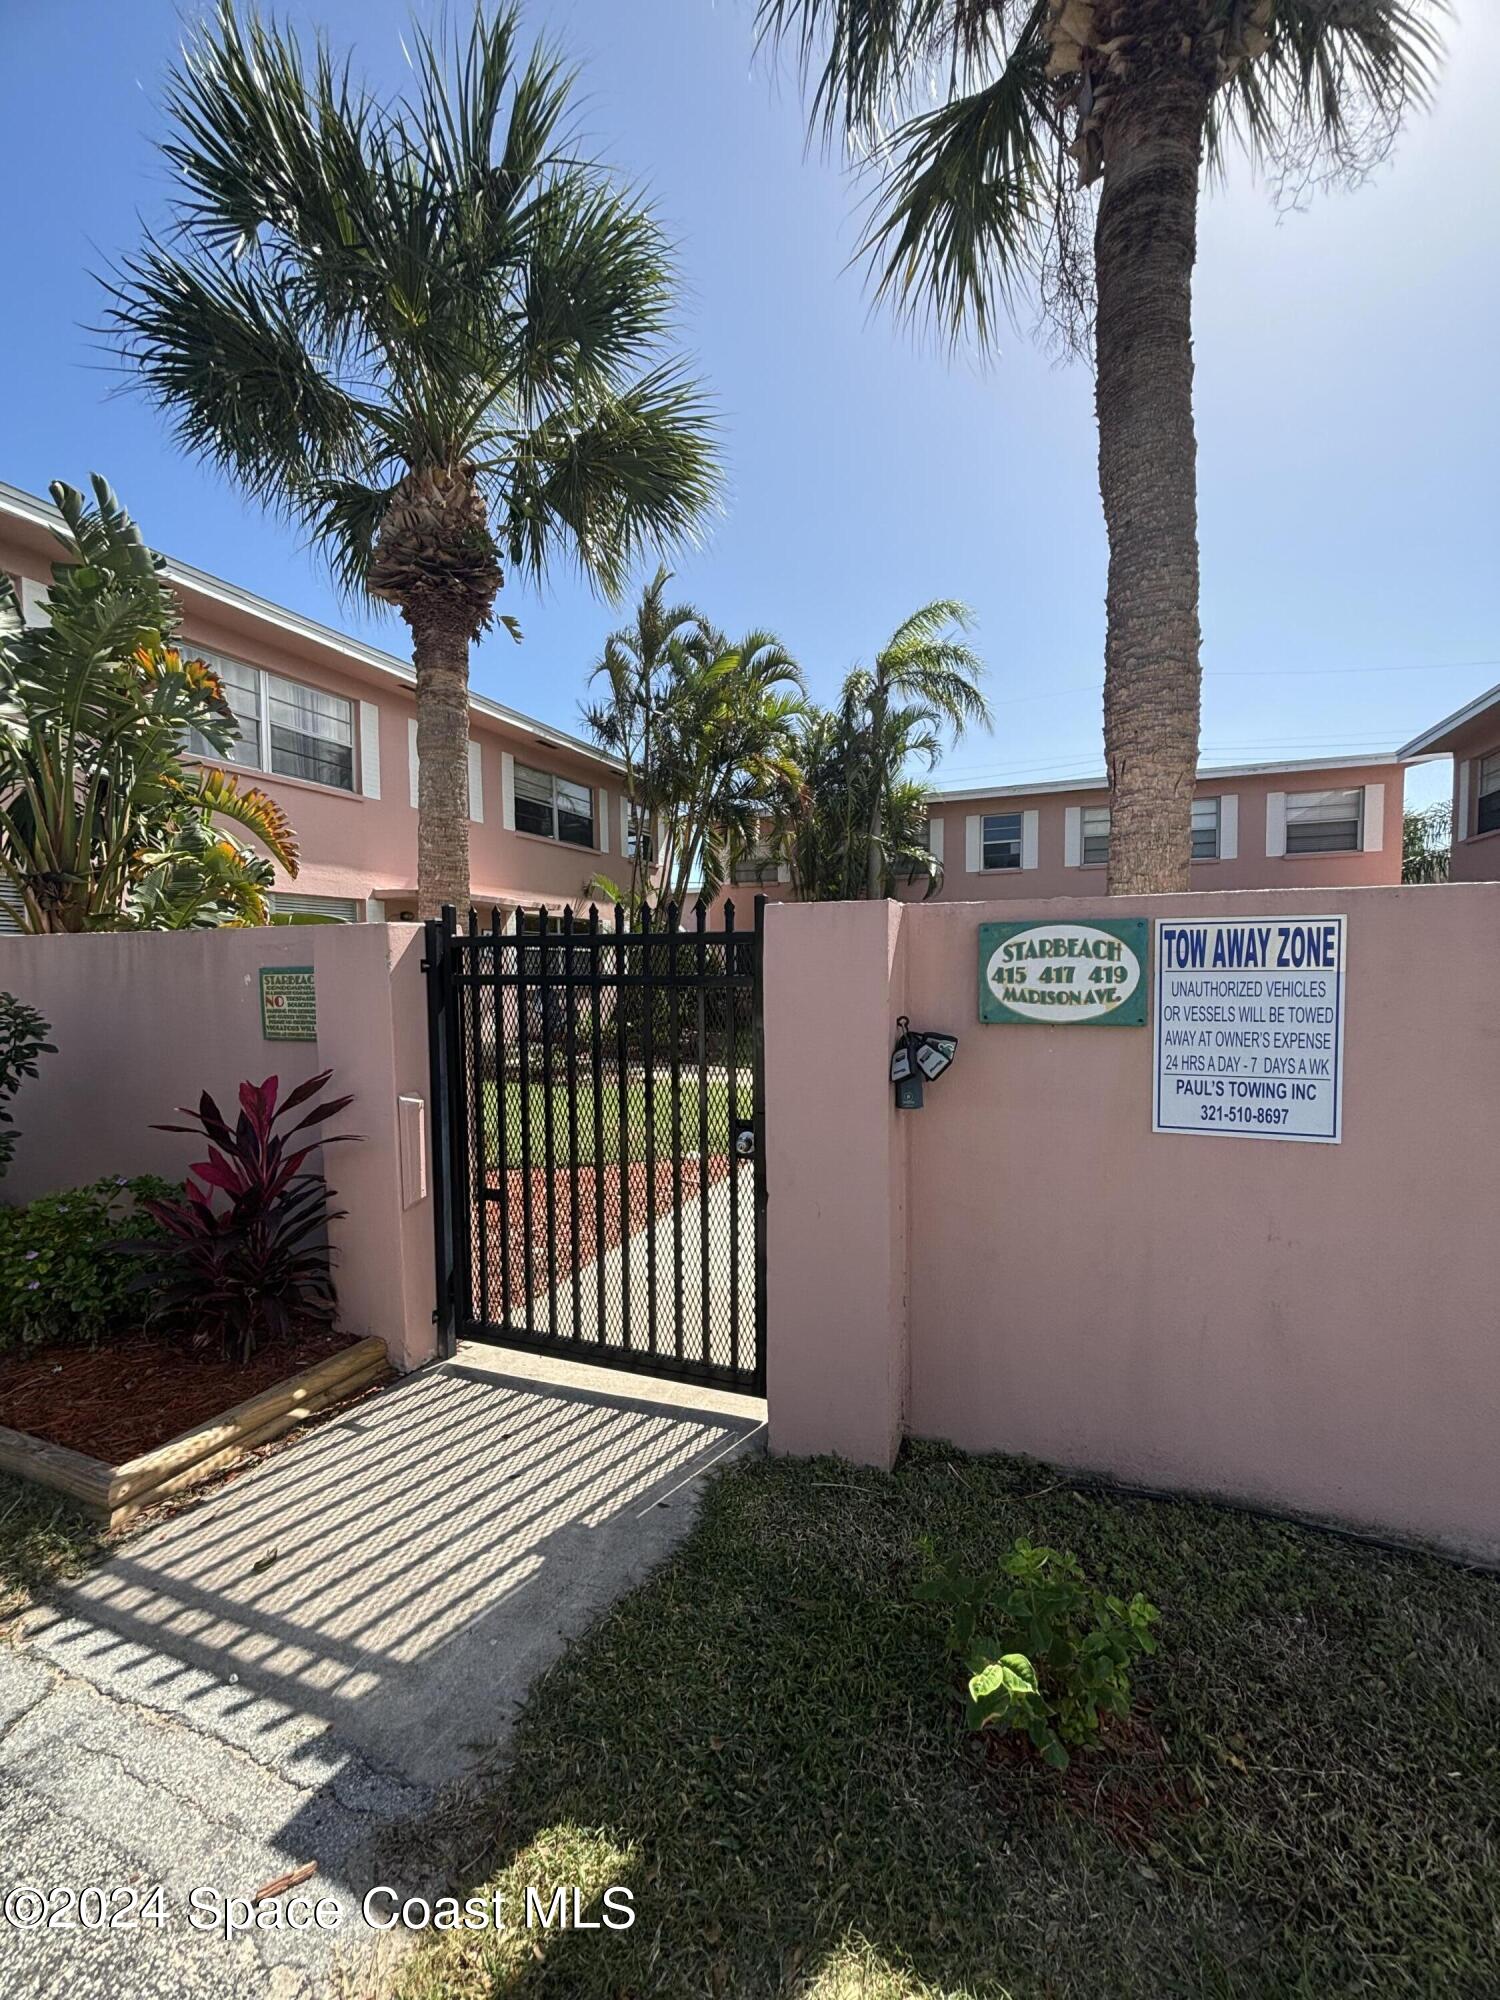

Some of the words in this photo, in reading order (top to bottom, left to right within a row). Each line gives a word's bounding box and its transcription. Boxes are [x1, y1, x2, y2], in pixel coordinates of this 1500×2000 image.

[1002, 938, 1121, 963] STARBEACH
[1165, 930, 1207, 968] TOW
[1212, 928, 1271, 968] AWAY
[1277, 927, 1335, 967] ZONE
[992, 967, 1026, 983] 415
[1039, 966, 1076, 983] 417
[1088, 966, 1127, 983] 419
[1003, 987, 1081, 1005] MADISON
[1084, 988, 1121, 1005] AVE.
[1171, 981, 1262, 997] UNAUTHORIZED
[1266, 981, 1326, 997] VEHICLES
[266, 996, 284, 1007] NO
[1164, 1006, 1182, 1021] OR
[1184, 1006, 1235, 1022] VESSELS
[1239, 1007, 1266, 1022] WILL
[1270, 1007, 1285, 1023] BE
[1288, 1007, 1334, 1023] TOWED
[1165, 1030, 1196, 1046] AWAY
[1198, 1031, 1212, 1047] AT
[1215, 1031, 1270, 1048] OWNER'S
[1274, 1032, 1331, 1049] EXPENSE
[1166, 1055, 1178, 1070] 24
[1181, 1055, 1204, 1071] HRS
[1208, 1056, 1216, 1071] A
[1218, 1056, 1240, 1072] DAY
[1251, 1058, 1257, 1072] 7
[1264, 1058, 1295, 1074] DAYS
[1298, 1059, 1306, 1074] A
[1309, 1059, 1329, 1075] WK
[1176, 1079, 1224, 1096] PAUL'S
[1229, 1081, 1287, 1099] TOWING
[1292, 1083, 1316, 1100] INC
[1201, 1105, 1289, 1124] 321-510-8697
